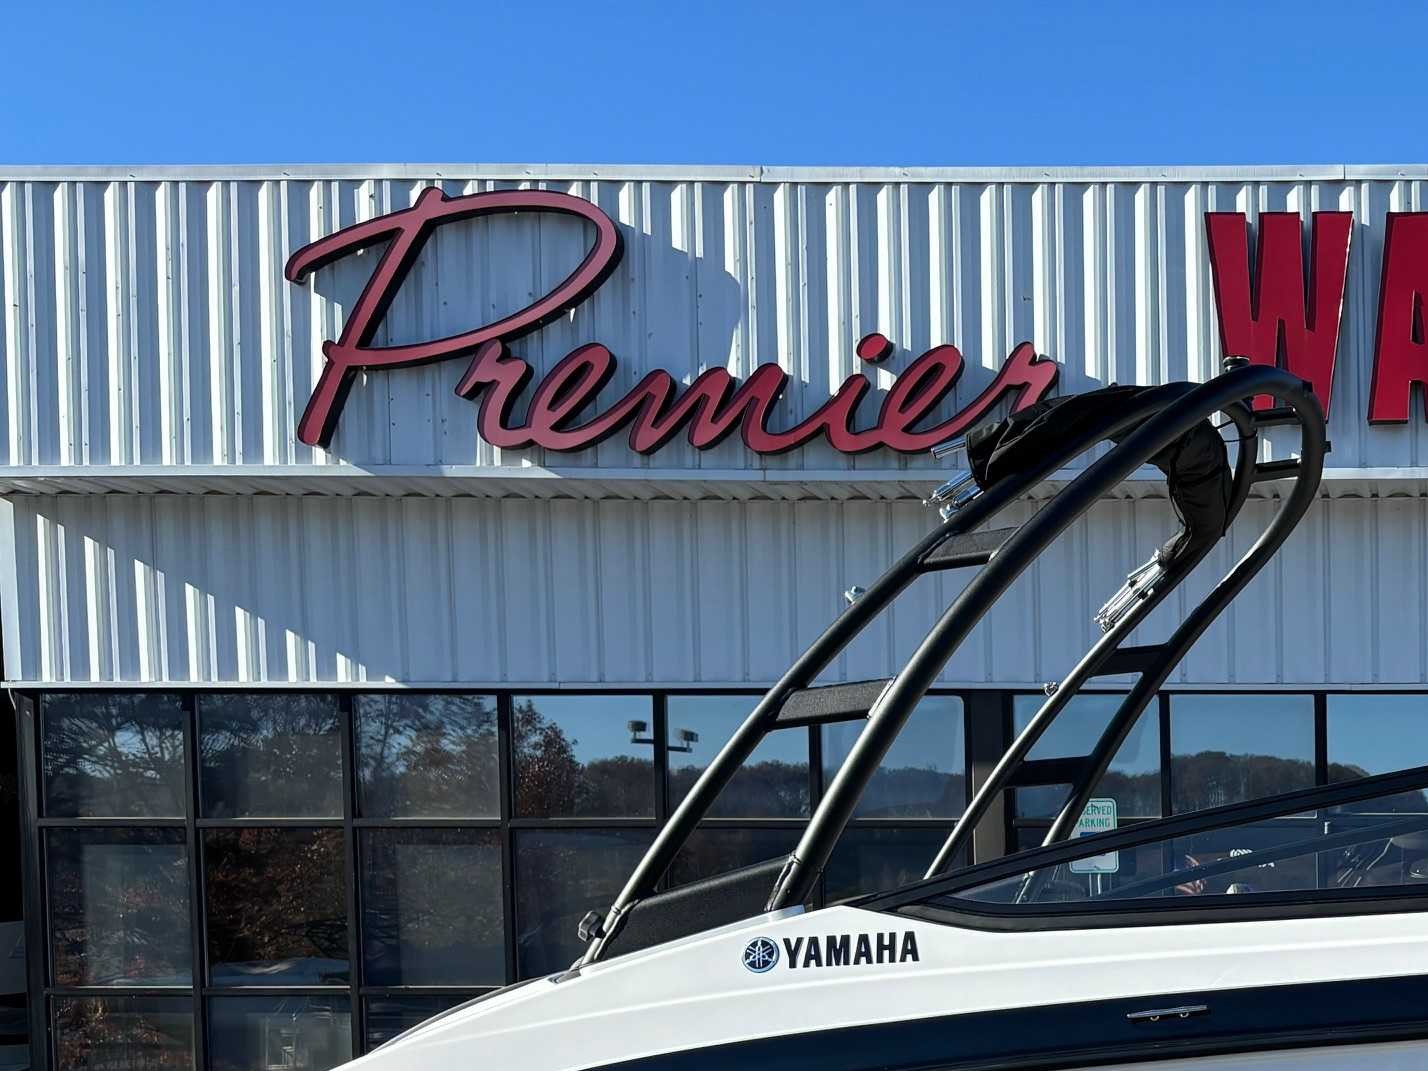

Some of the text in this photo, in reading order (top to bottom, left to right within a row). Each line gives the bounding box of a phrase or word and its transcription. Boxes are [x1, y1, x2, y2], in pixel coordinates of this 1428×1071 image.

[285, 186, 1060, 454] Premier
[1079, 818, 1111, 828] ARKING
[783, 931, 920, 969] YAMAHA
